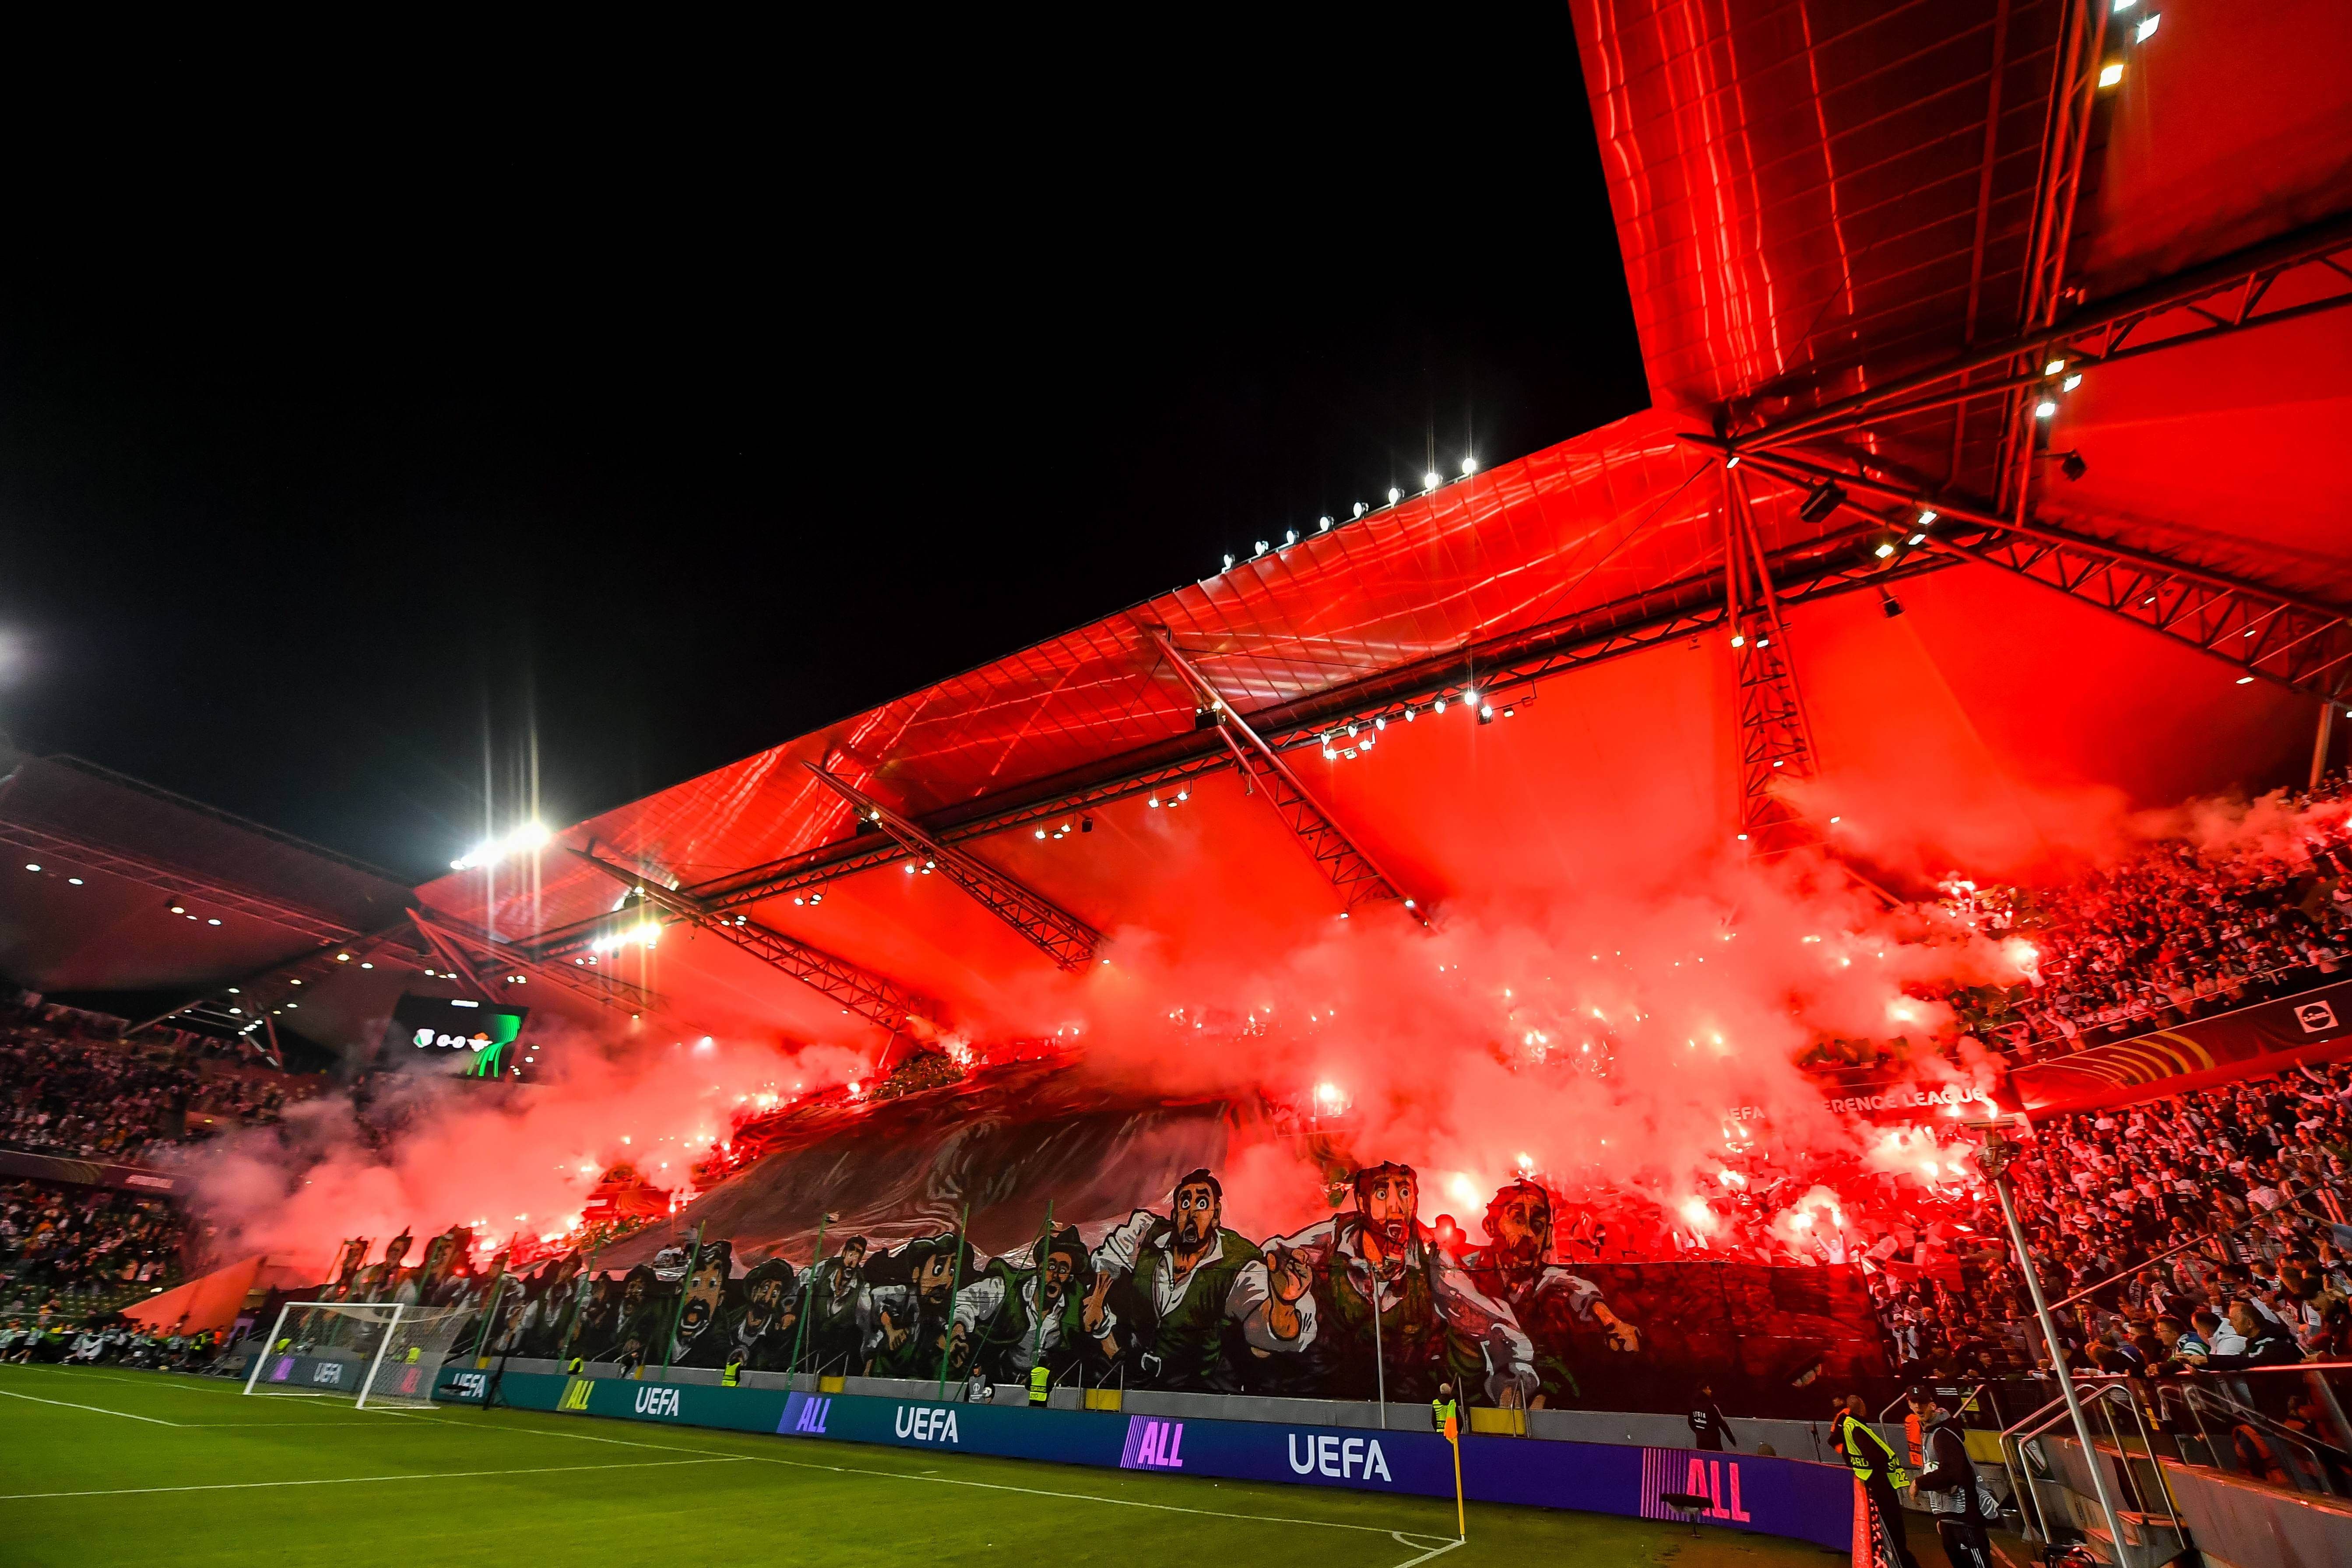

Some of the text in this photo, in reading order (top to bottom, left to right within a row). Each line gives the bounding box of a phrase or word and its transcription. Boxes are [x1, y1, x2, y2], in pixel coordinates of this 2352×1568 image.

[1723, 1106, 1765, 1121] EFA
[566, 1379, 595, 1410] ALL
[635, 1387, 680, 1416] UEFA
[796, 1397, 831, 1433] ALL
[895, 1406, 959, 1443] UEFA
[1138, 1422, 1184, 1467] ALL
[1289, 1434, 1392, 1482] UEFA
[1686, 1459, 1750, 1522] ALL
